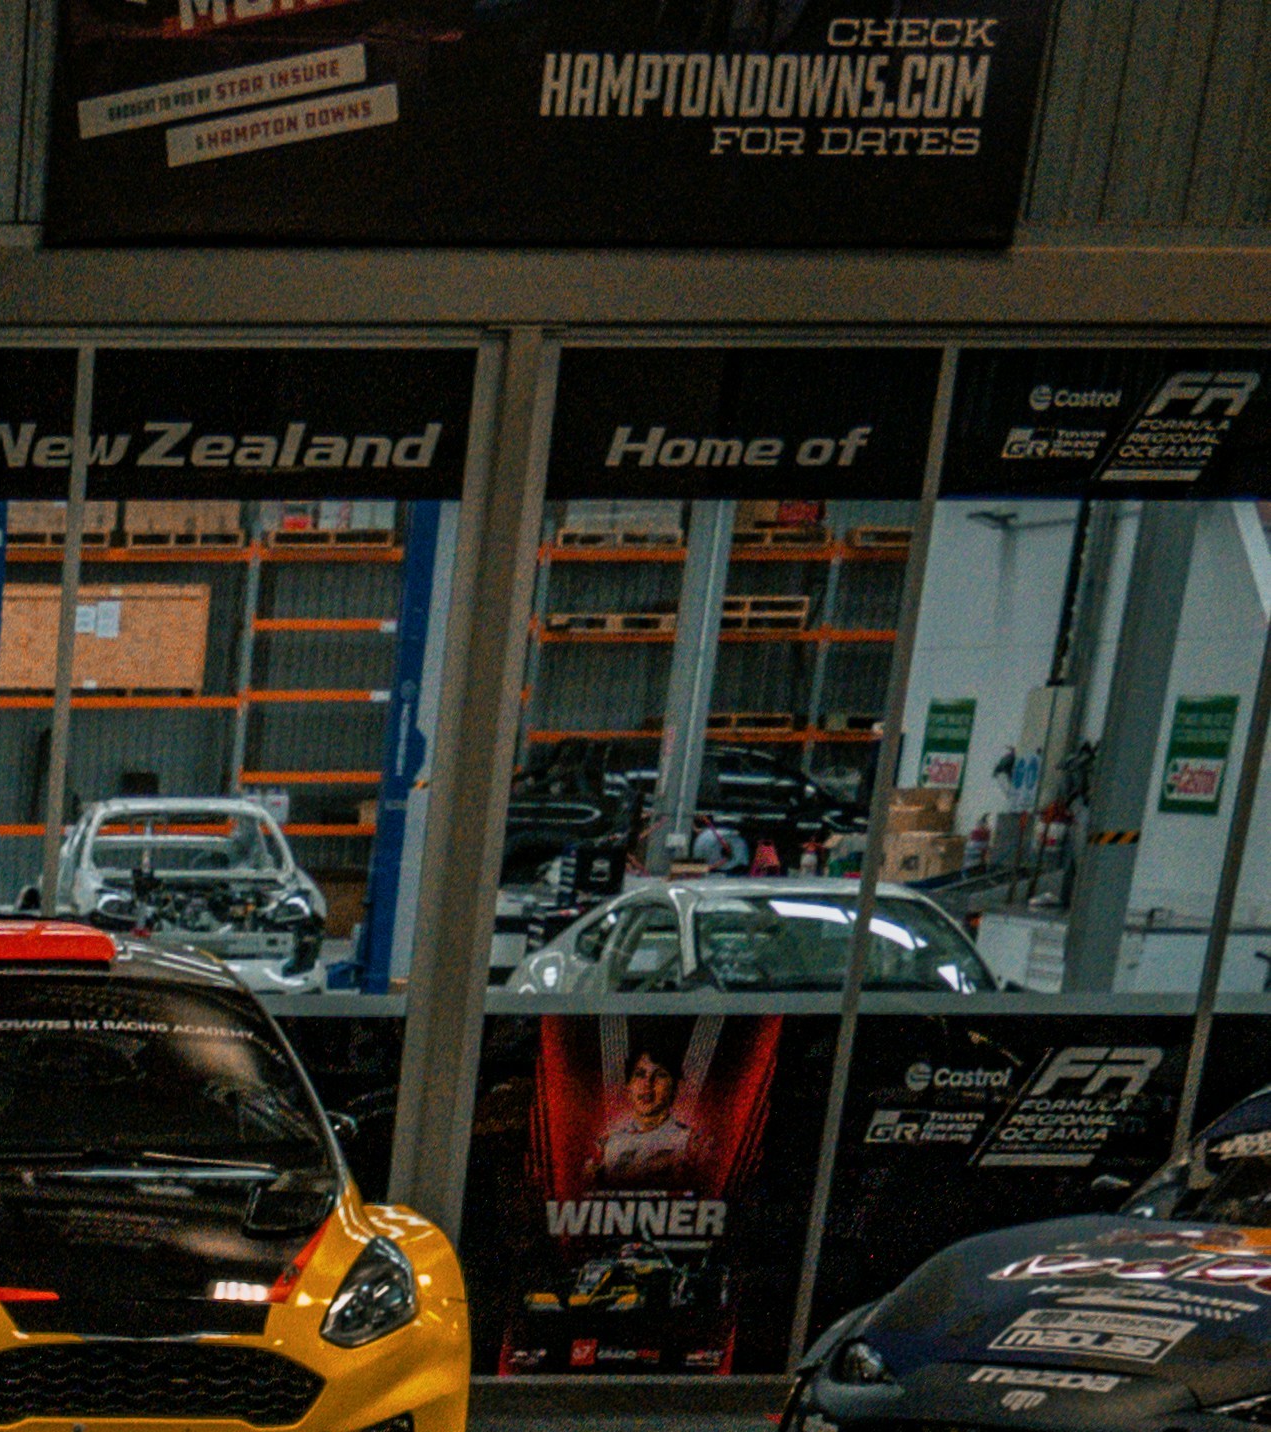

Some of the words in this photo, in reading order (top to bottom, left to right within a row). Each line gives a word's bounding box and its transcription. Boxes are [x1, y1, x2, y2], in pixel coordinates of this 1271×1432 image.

[827, 19, 998, 47] CHECK
[216, 76, 263, 99] STAR
[270, 59, 340, 88] INSURE
[540, 54, 990, 118] HAMPTONDOWNS.COM
[207, 115, 299, 148] HAMPTON
[305, 101, 372, 128] DOWNS
[710, 128, 804, 155] FOR
[818, 128, 980, 155] DATES
[1053, 389, 1122, 409] Castrol
[1135, 420, 1230, 431] FORMULA
[135, 422, 443, 469] Zealand
[604, 427, 780, 467] Home
[796, 427, 873, 467] of
[1124, 432, 1221, 444] REGIONAL
[1118, 445, 1214, 459] OCEANIA
[102, 1020, 168, 1033] RACING
[173, 1023, 255, 1039] ACADEMY
[933, 1066, 1012, 1089] Castrol
[1019, 1099, 1129, 1112] FORMULA
[1007, 1113, 1117, 1126] REGIONAL
[999, 1127, 1108, 1142] OCEANIA
[545, 1199, 727, 1236] WINNER
[1075, 1313, 1181, 1333] MOTORSPORT
[967, 1365, 1121, 1393] mazda
